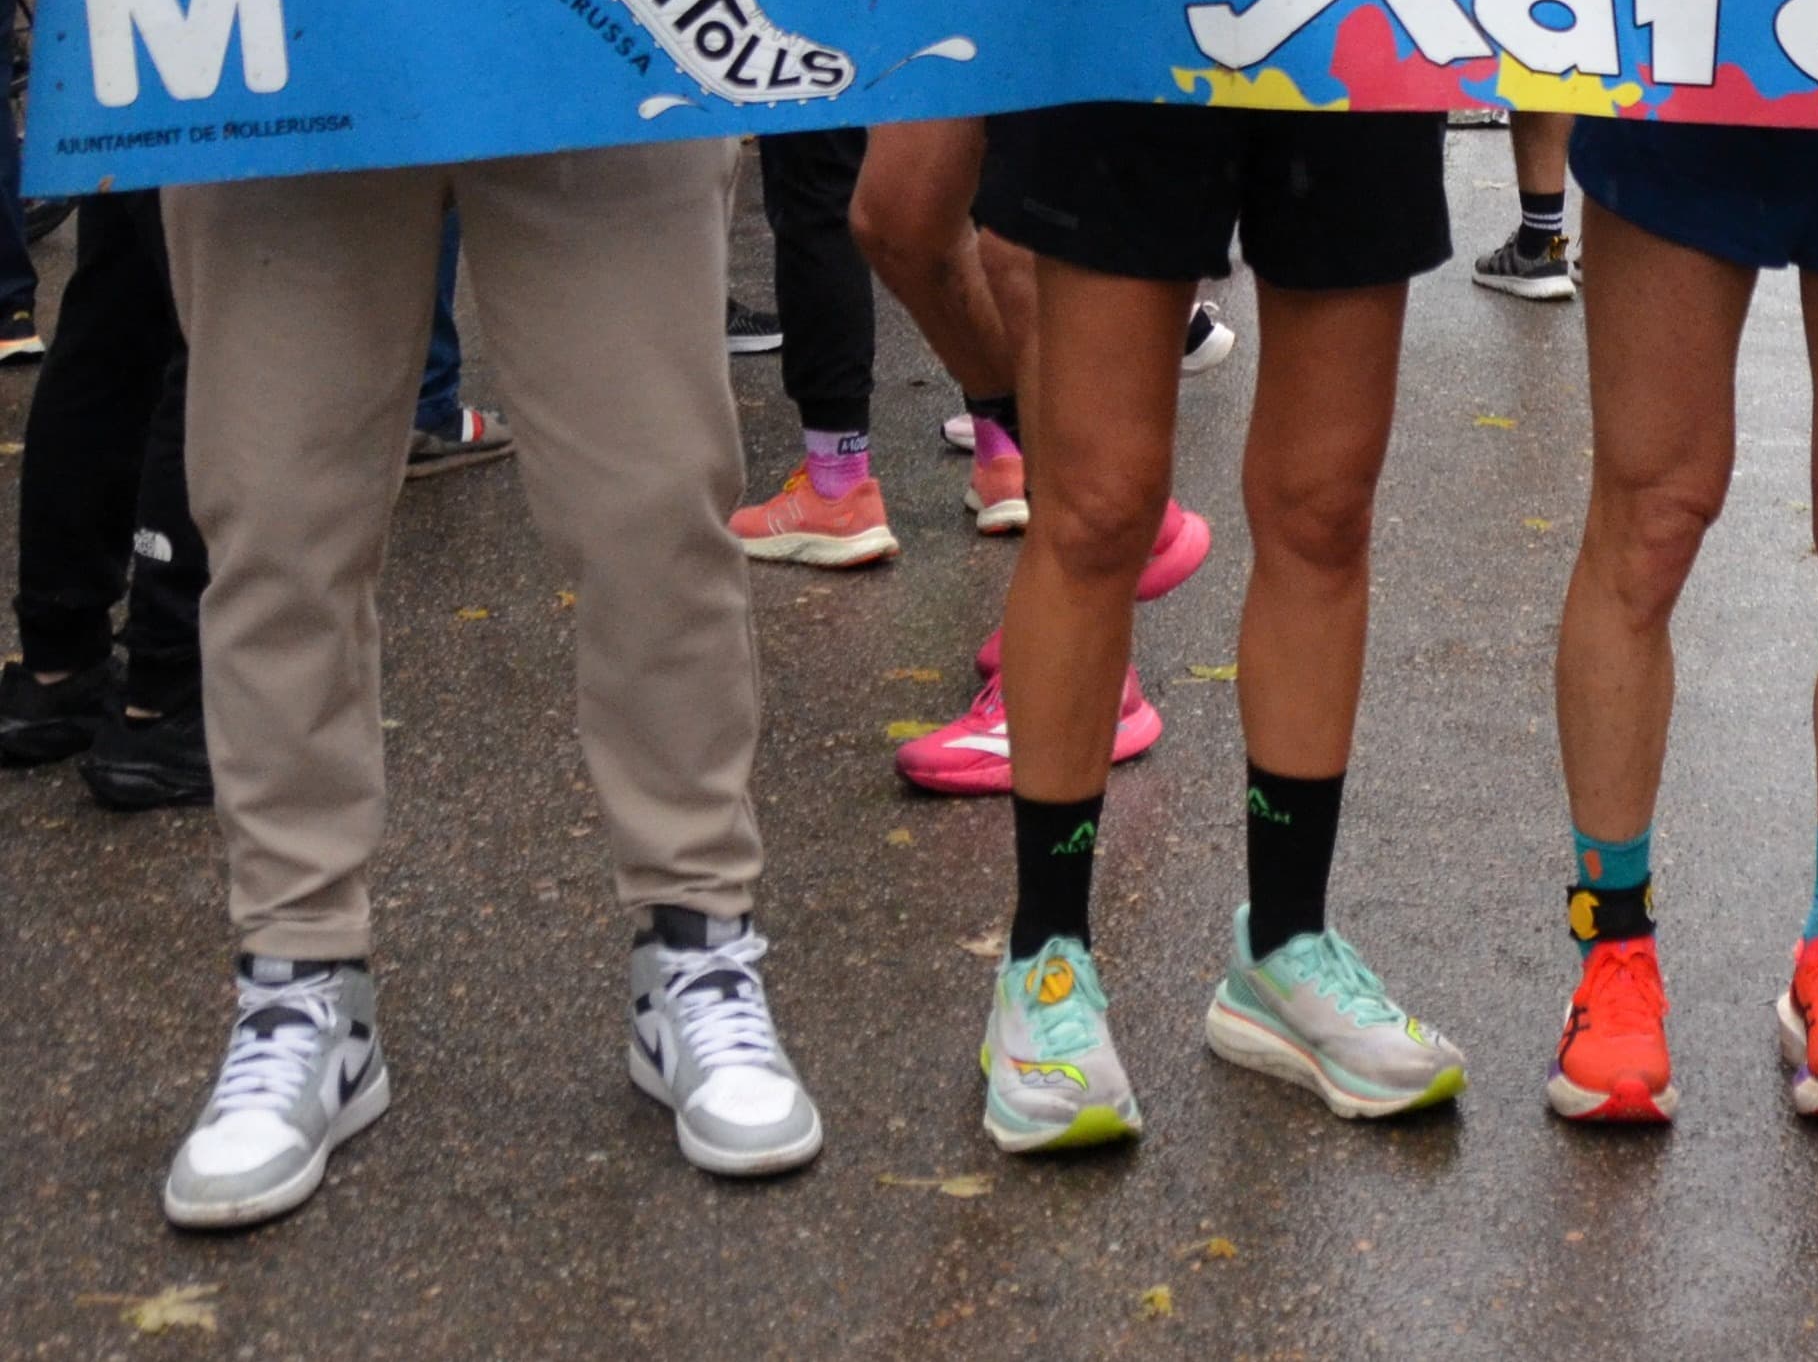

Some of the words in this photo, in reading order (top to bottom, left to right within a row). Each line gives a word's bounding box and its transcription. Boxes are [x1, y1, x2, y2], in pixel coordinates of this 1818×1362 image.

[57, 126, 182, 156] AJUNTAMENT
[188, 125, 217, 144] DE
[222, 113, 354, 142] MOLLERUSSA
